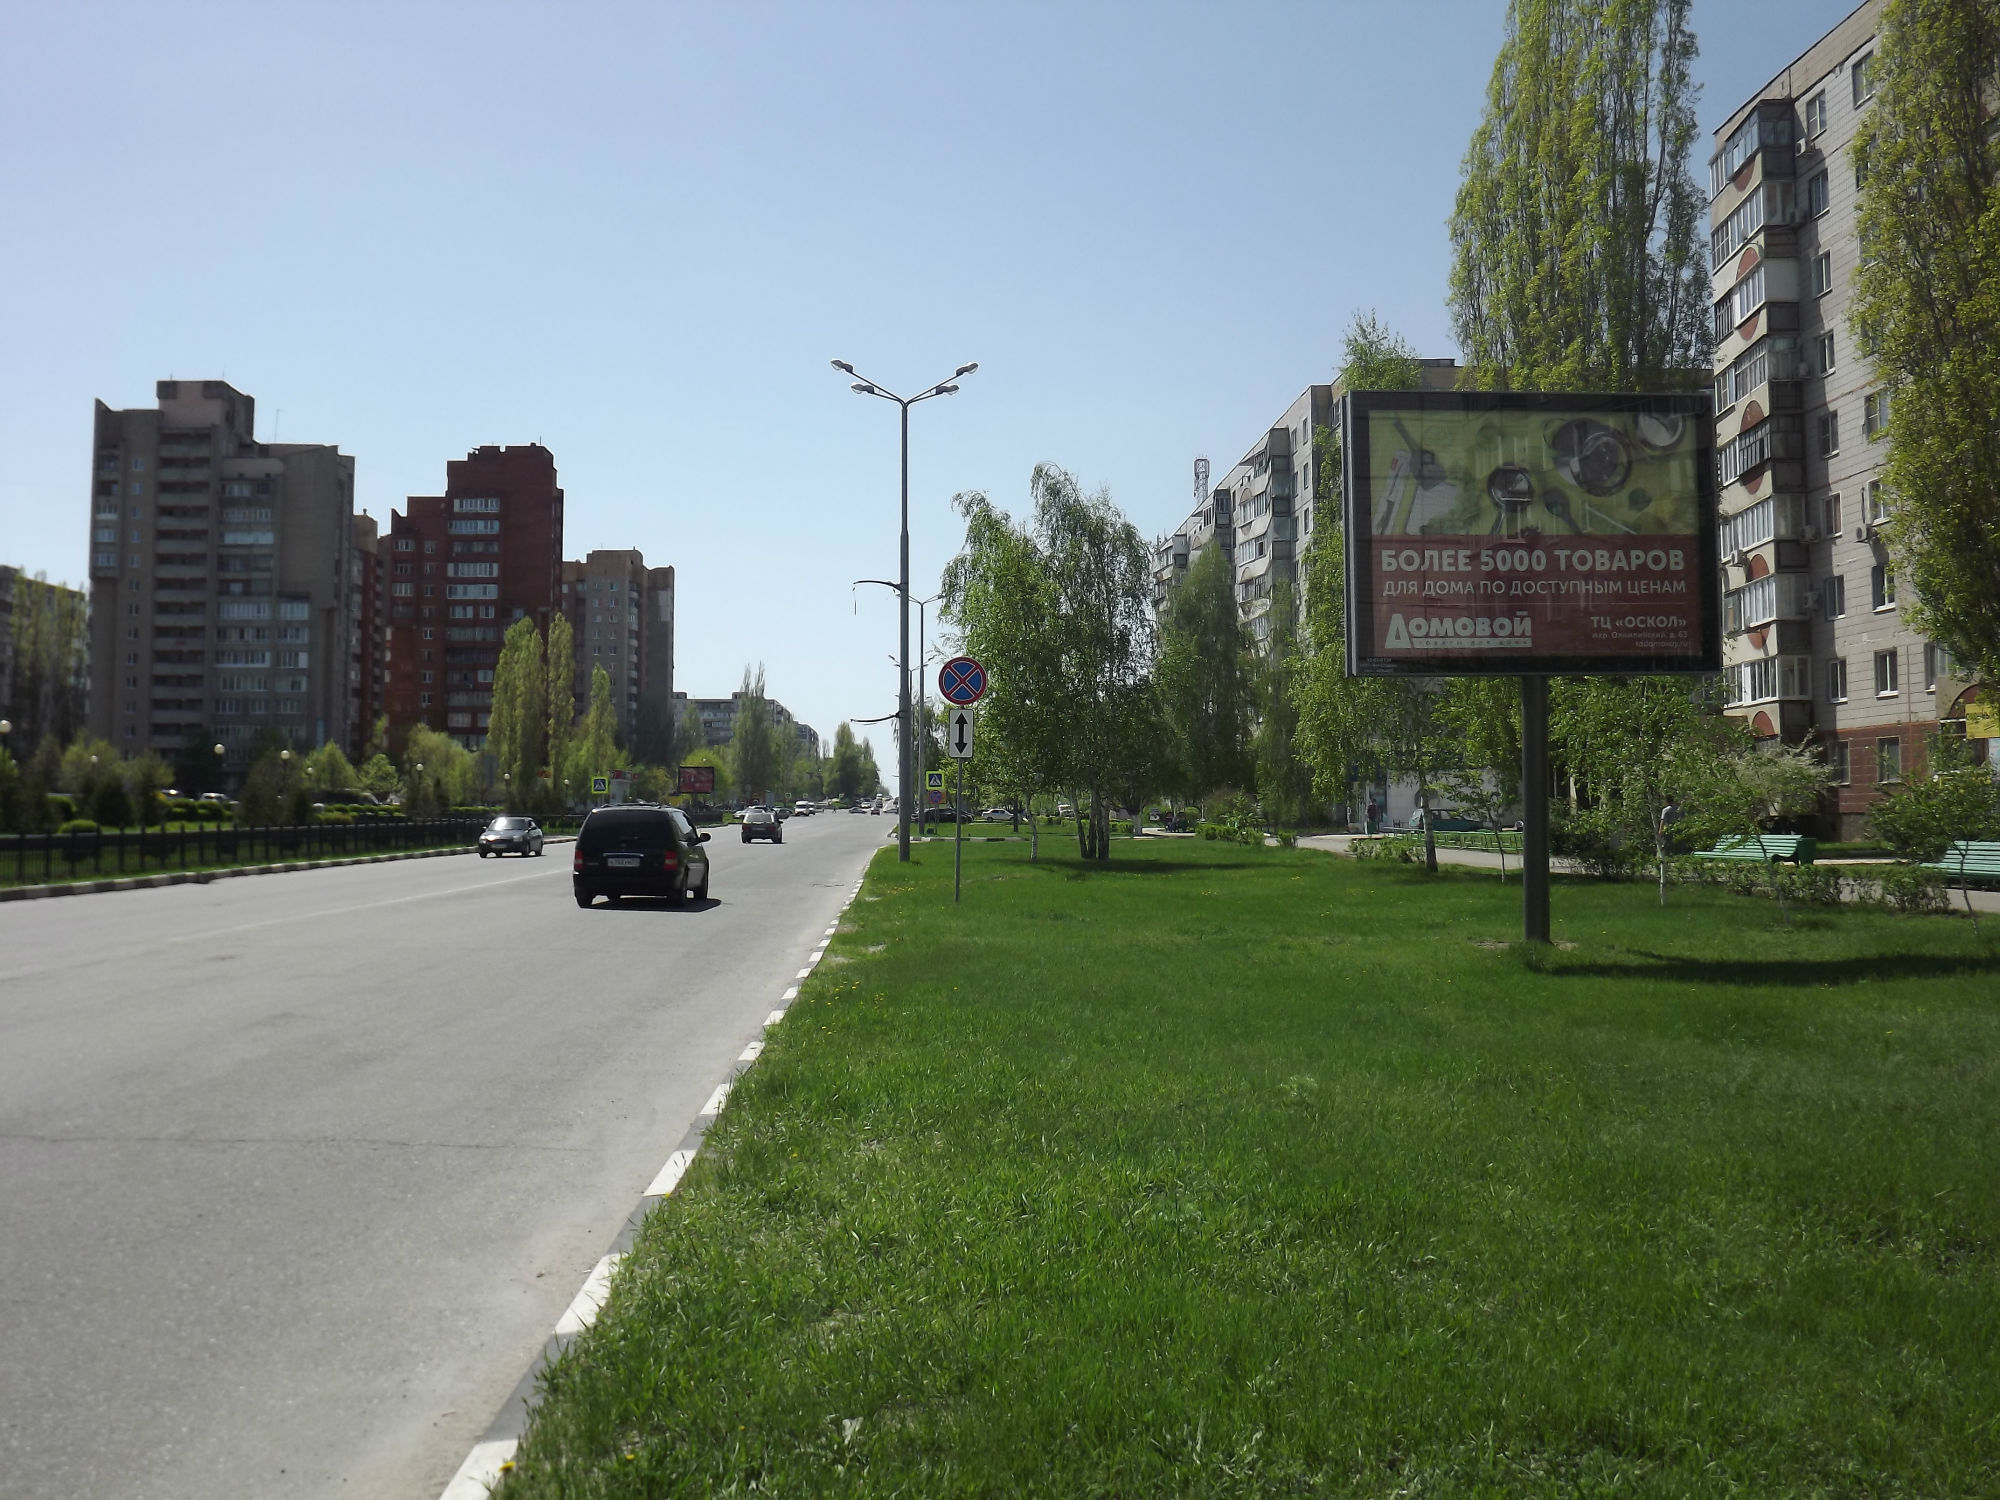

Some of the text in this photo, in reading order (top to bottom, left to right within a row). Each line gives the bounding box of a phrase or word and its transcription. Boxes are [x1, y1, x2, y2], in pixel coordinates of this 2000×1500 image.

[1381, 549, 1685, 572] БОЛЕЕ 5000 ТОВАРОВ
[1382, 580, 1686, 597] ДЛЯ ДОМА ПО ДОСТУПНЫМ ЦЕНАМ
[1590, 615, 1687, 630] ТЦ «ОСКОЛ»
